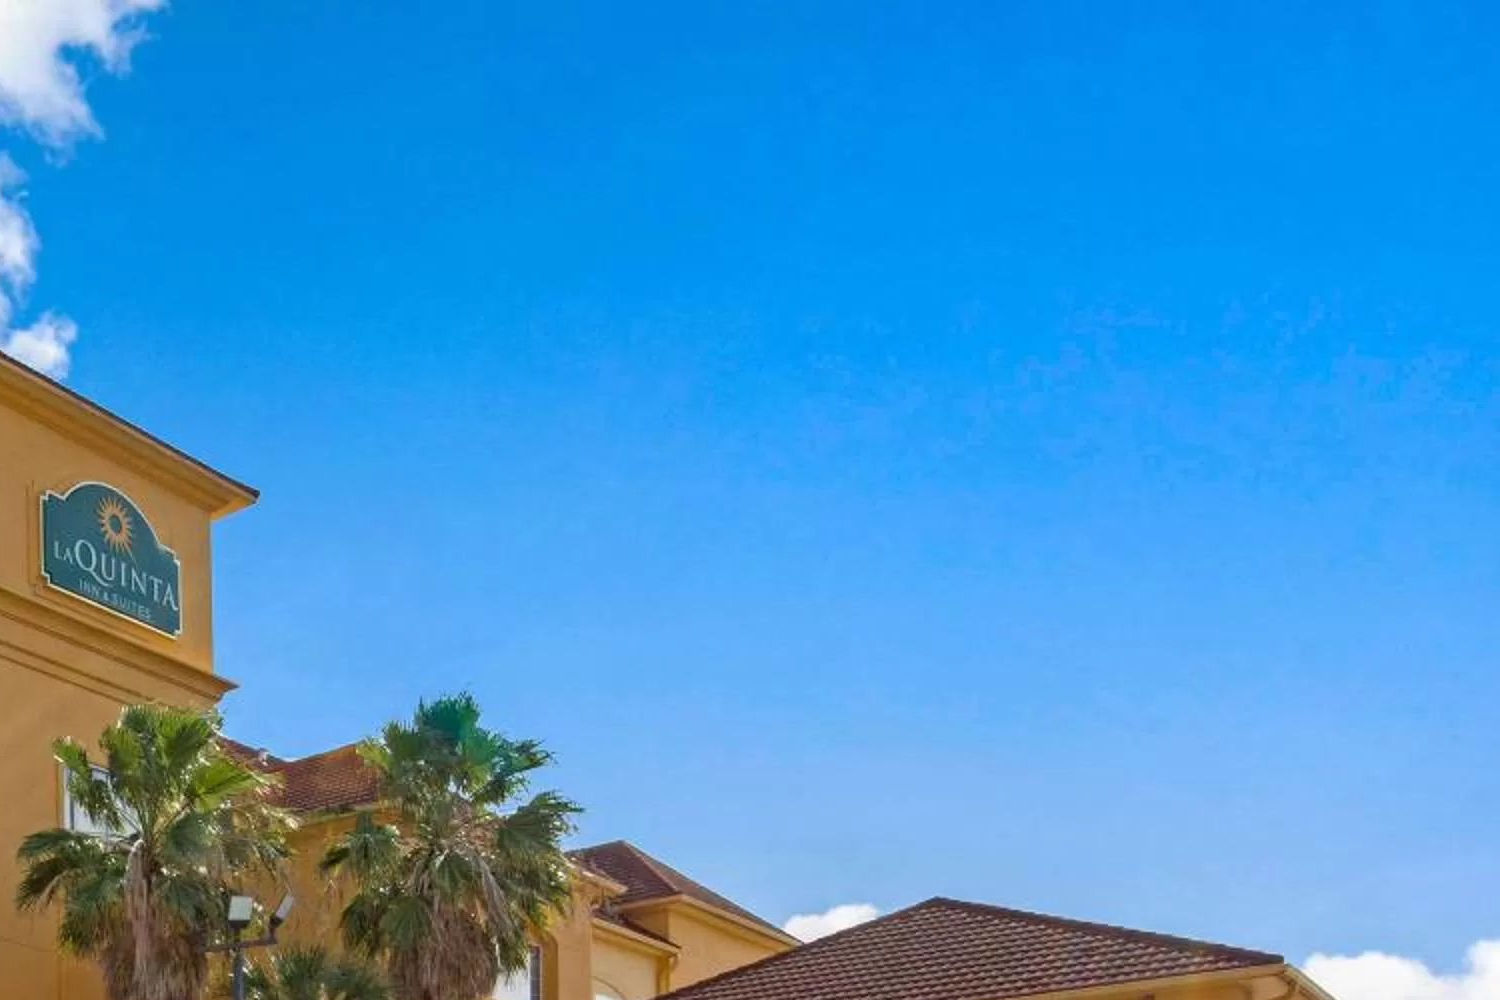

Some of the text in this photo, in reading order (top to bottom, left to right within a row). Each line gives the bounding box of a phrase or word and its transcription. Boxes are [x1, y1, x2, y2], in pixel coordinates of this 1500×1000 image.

[54, 539, 179, 611] LA QUINTA
[111, 593, 150, 619] SUITES
